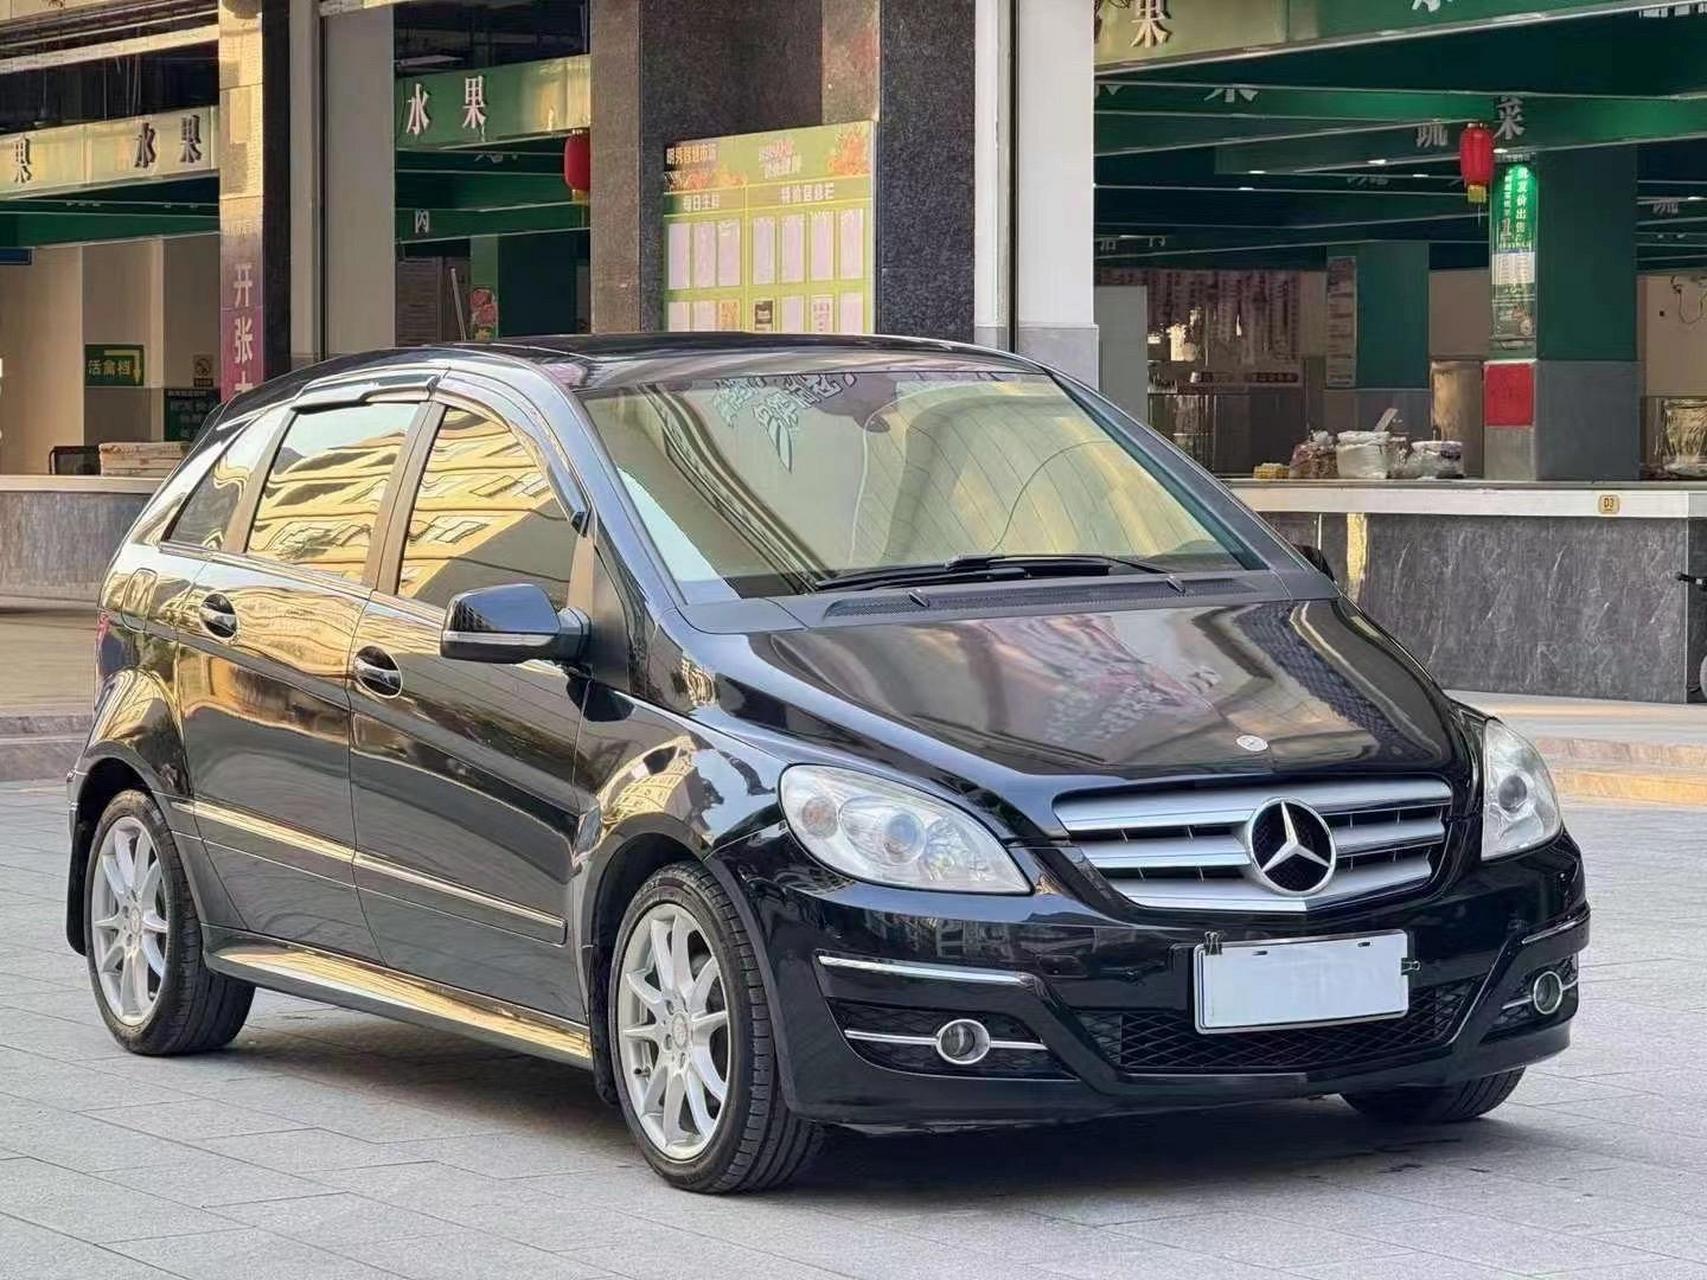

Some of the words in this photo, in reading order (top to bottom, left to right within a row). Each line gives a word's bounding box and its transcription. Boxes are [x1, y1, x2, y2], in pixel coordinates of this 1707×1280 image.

[406, 75, 487, 136] 水果
[14, 138, 32, 183] 果
[134, 115, 202, 168] 水果
